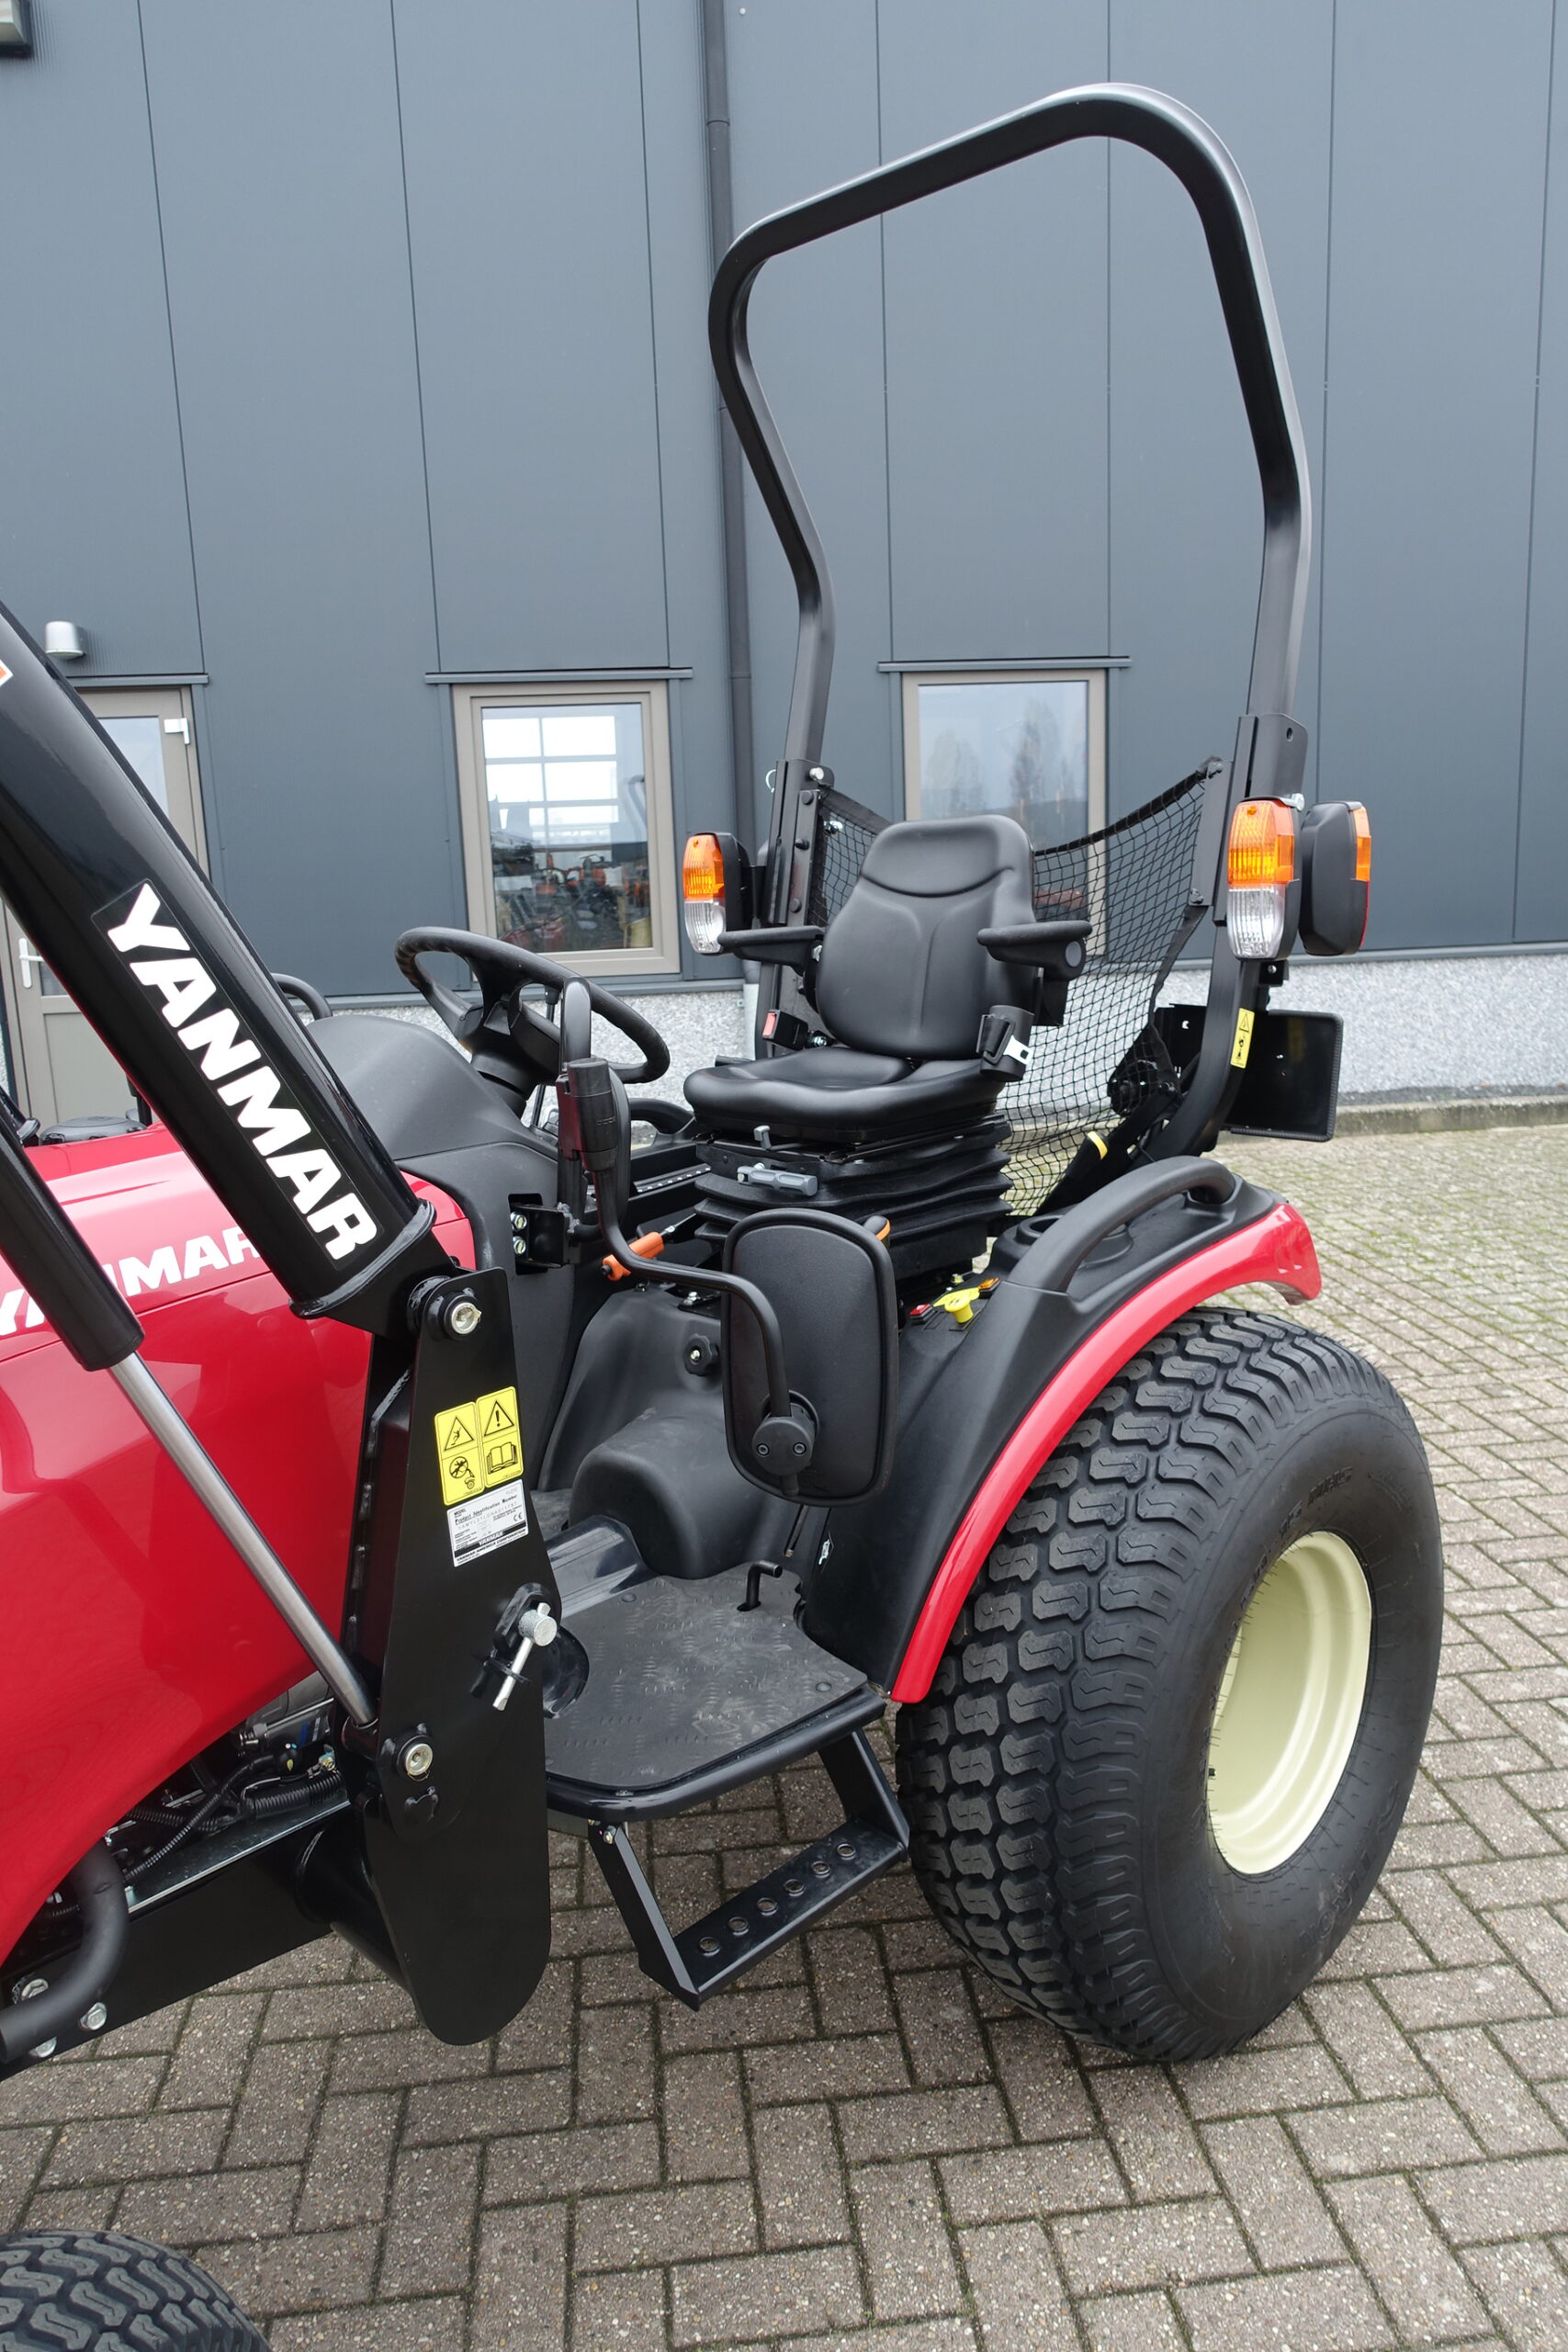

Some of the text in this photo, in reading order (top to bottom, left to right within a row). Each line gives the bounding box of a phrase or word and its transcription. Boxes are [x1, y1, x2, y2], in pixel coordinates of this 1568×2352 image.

[107, 883, 377, 1260] YANMAR
[502, 1494, 517, 1503] Number
[479, 1531, 502, 1545] YANMAR
